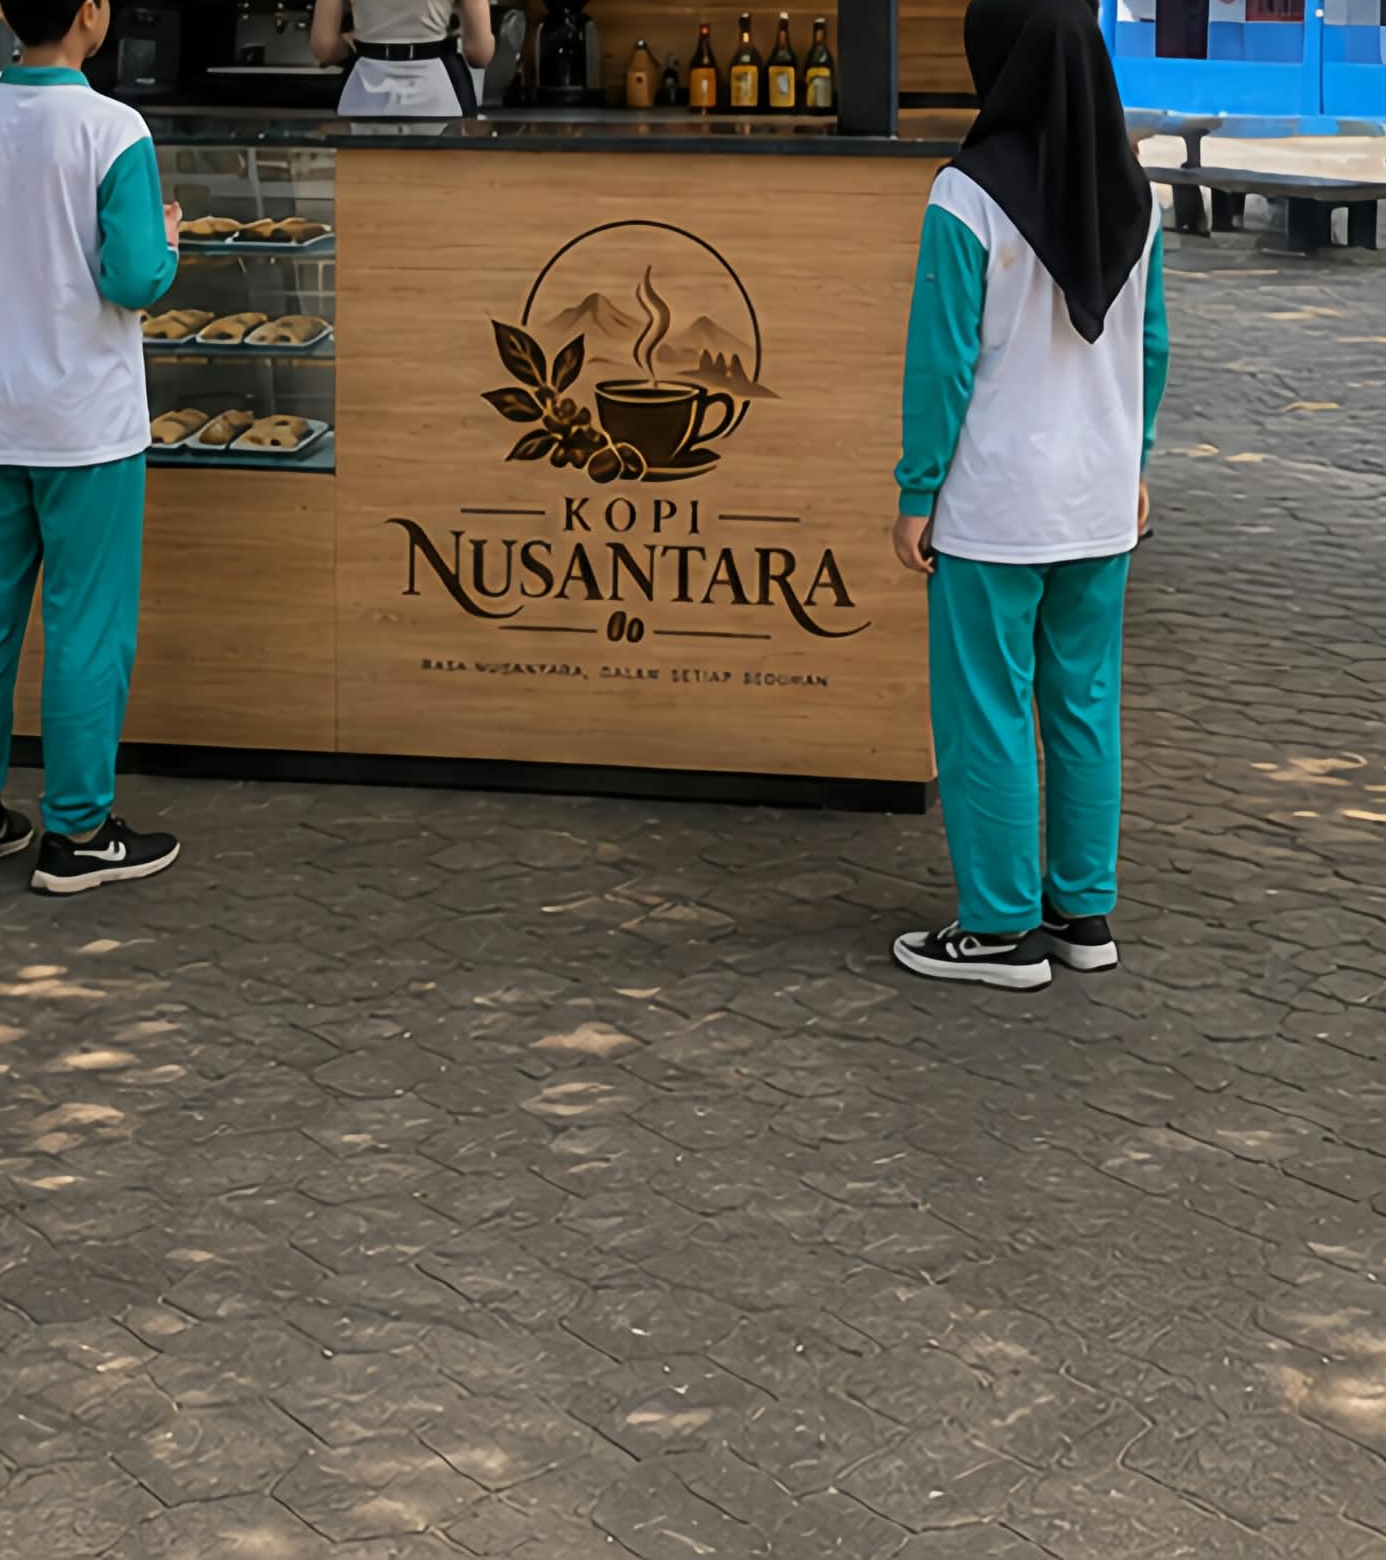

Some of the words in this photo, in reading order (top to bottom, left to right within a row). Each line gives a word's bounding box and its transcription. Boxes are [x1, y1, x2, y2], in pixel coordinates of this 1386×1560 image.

[564, 497, 700, 534] KOPI
[384, 517, 873, 638] NUSANTARA
[671, 668, 732, 684] SETIAP
